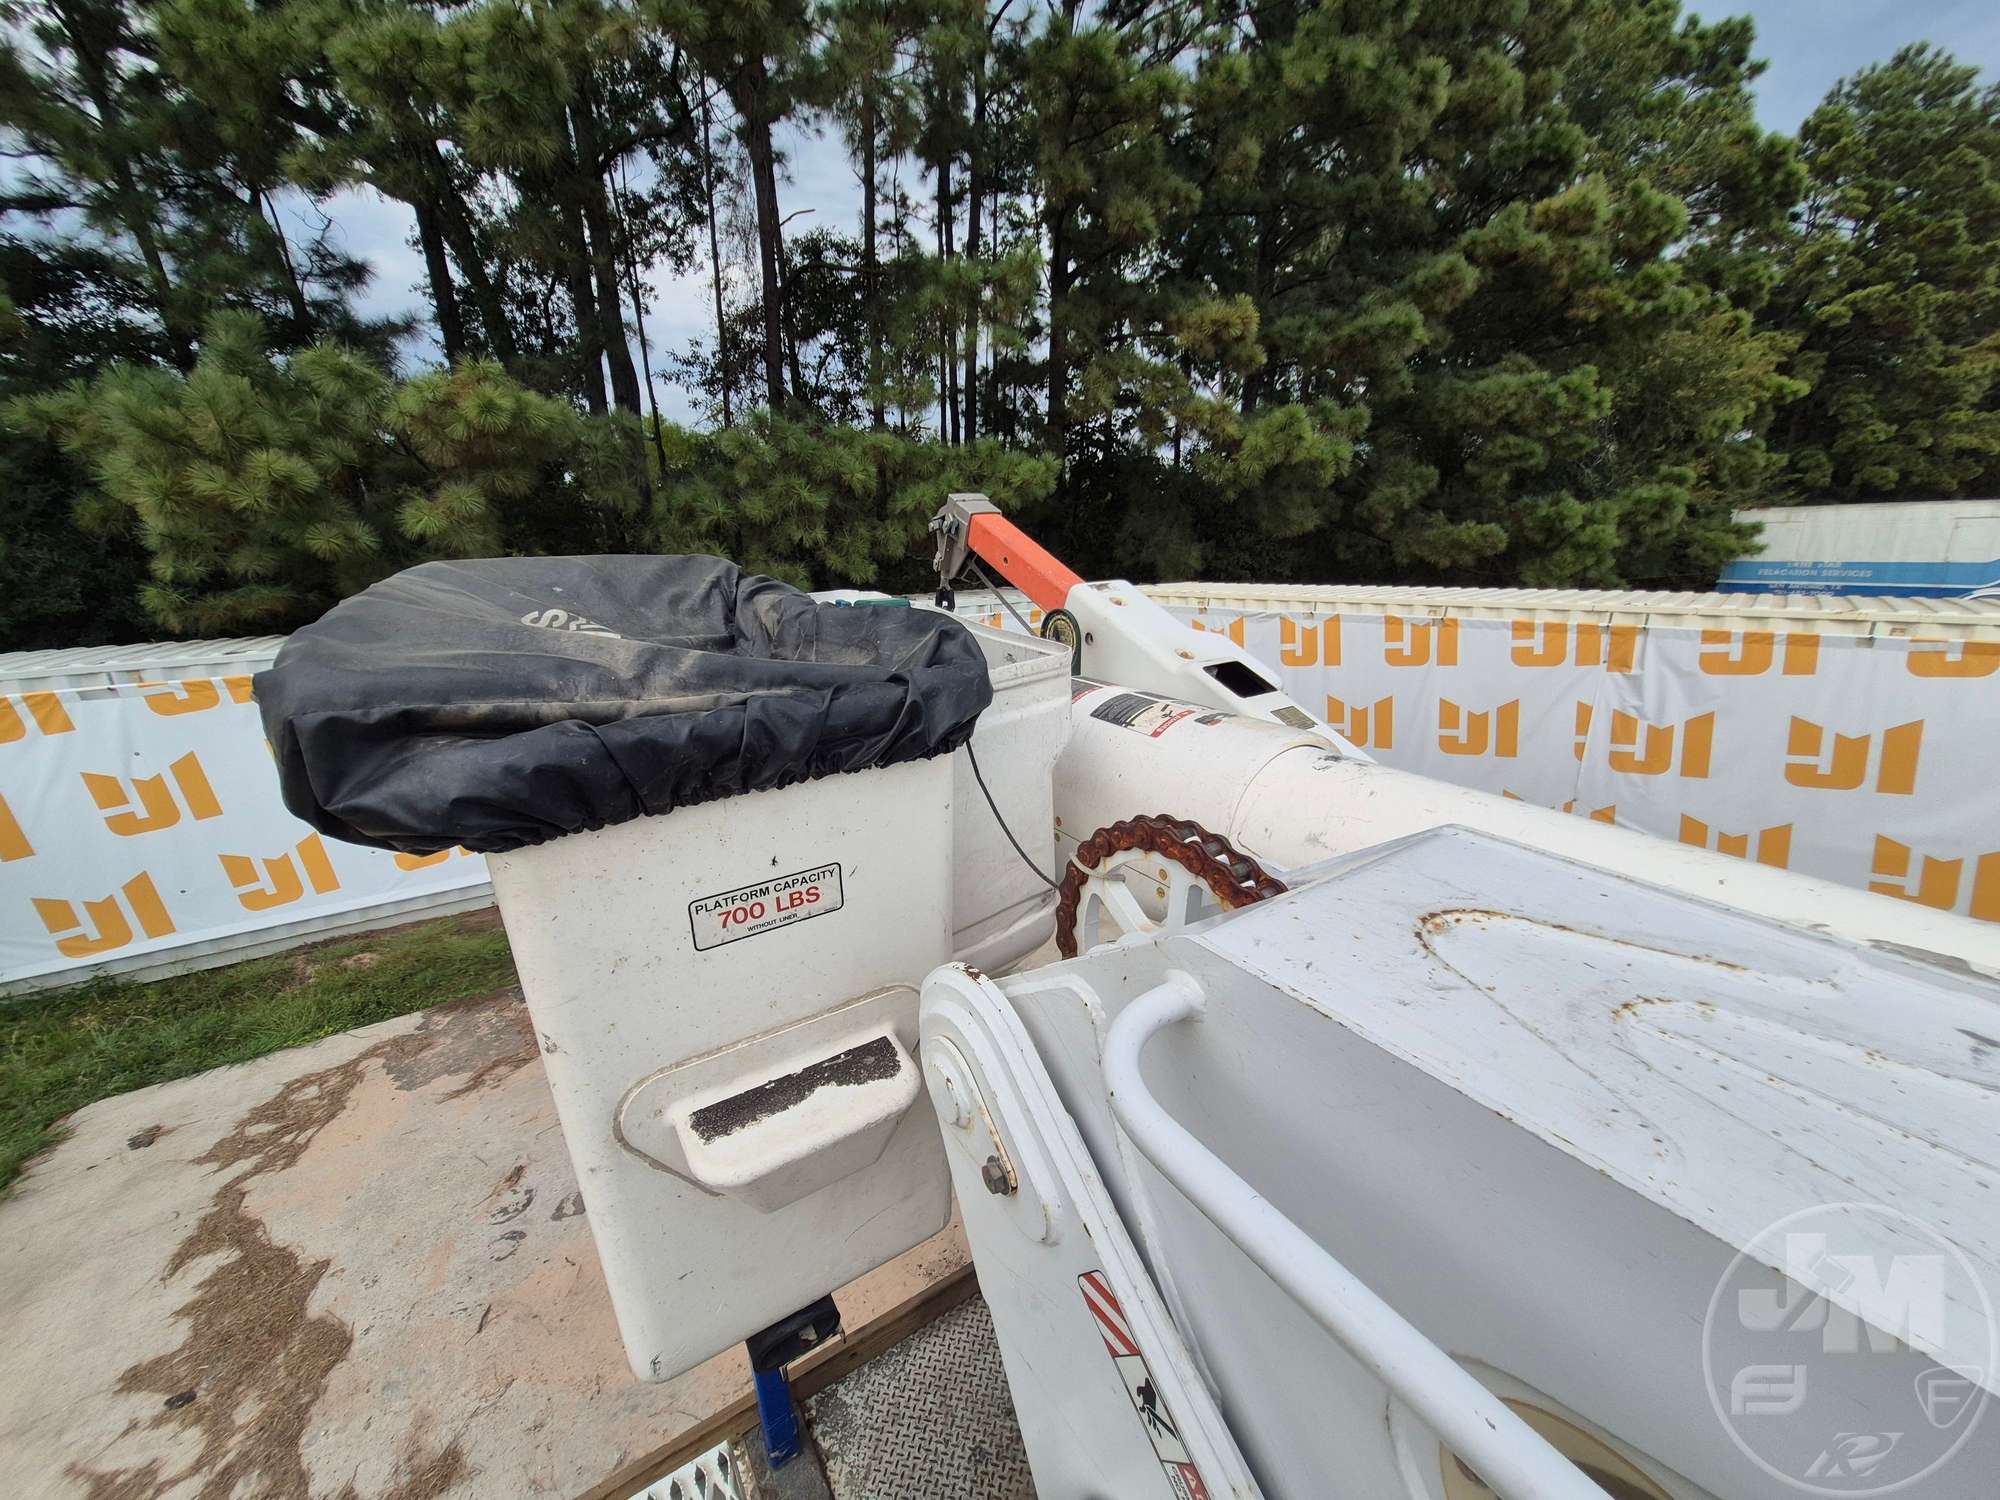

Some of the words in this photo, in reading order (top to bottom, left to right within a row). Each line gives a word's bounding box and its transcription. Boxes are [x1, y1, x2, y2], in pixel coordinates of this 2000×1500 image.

[1821, 569, 1872, 578] SERVICES
[695, 886, 770, 915] PLATFORM
[774, 868, 836, 892] CAPACITY
[717, 901, 766, 929] 700
[775, 885, 821, 913] LBS
[746, 919, 778, 932] WITHOUT
